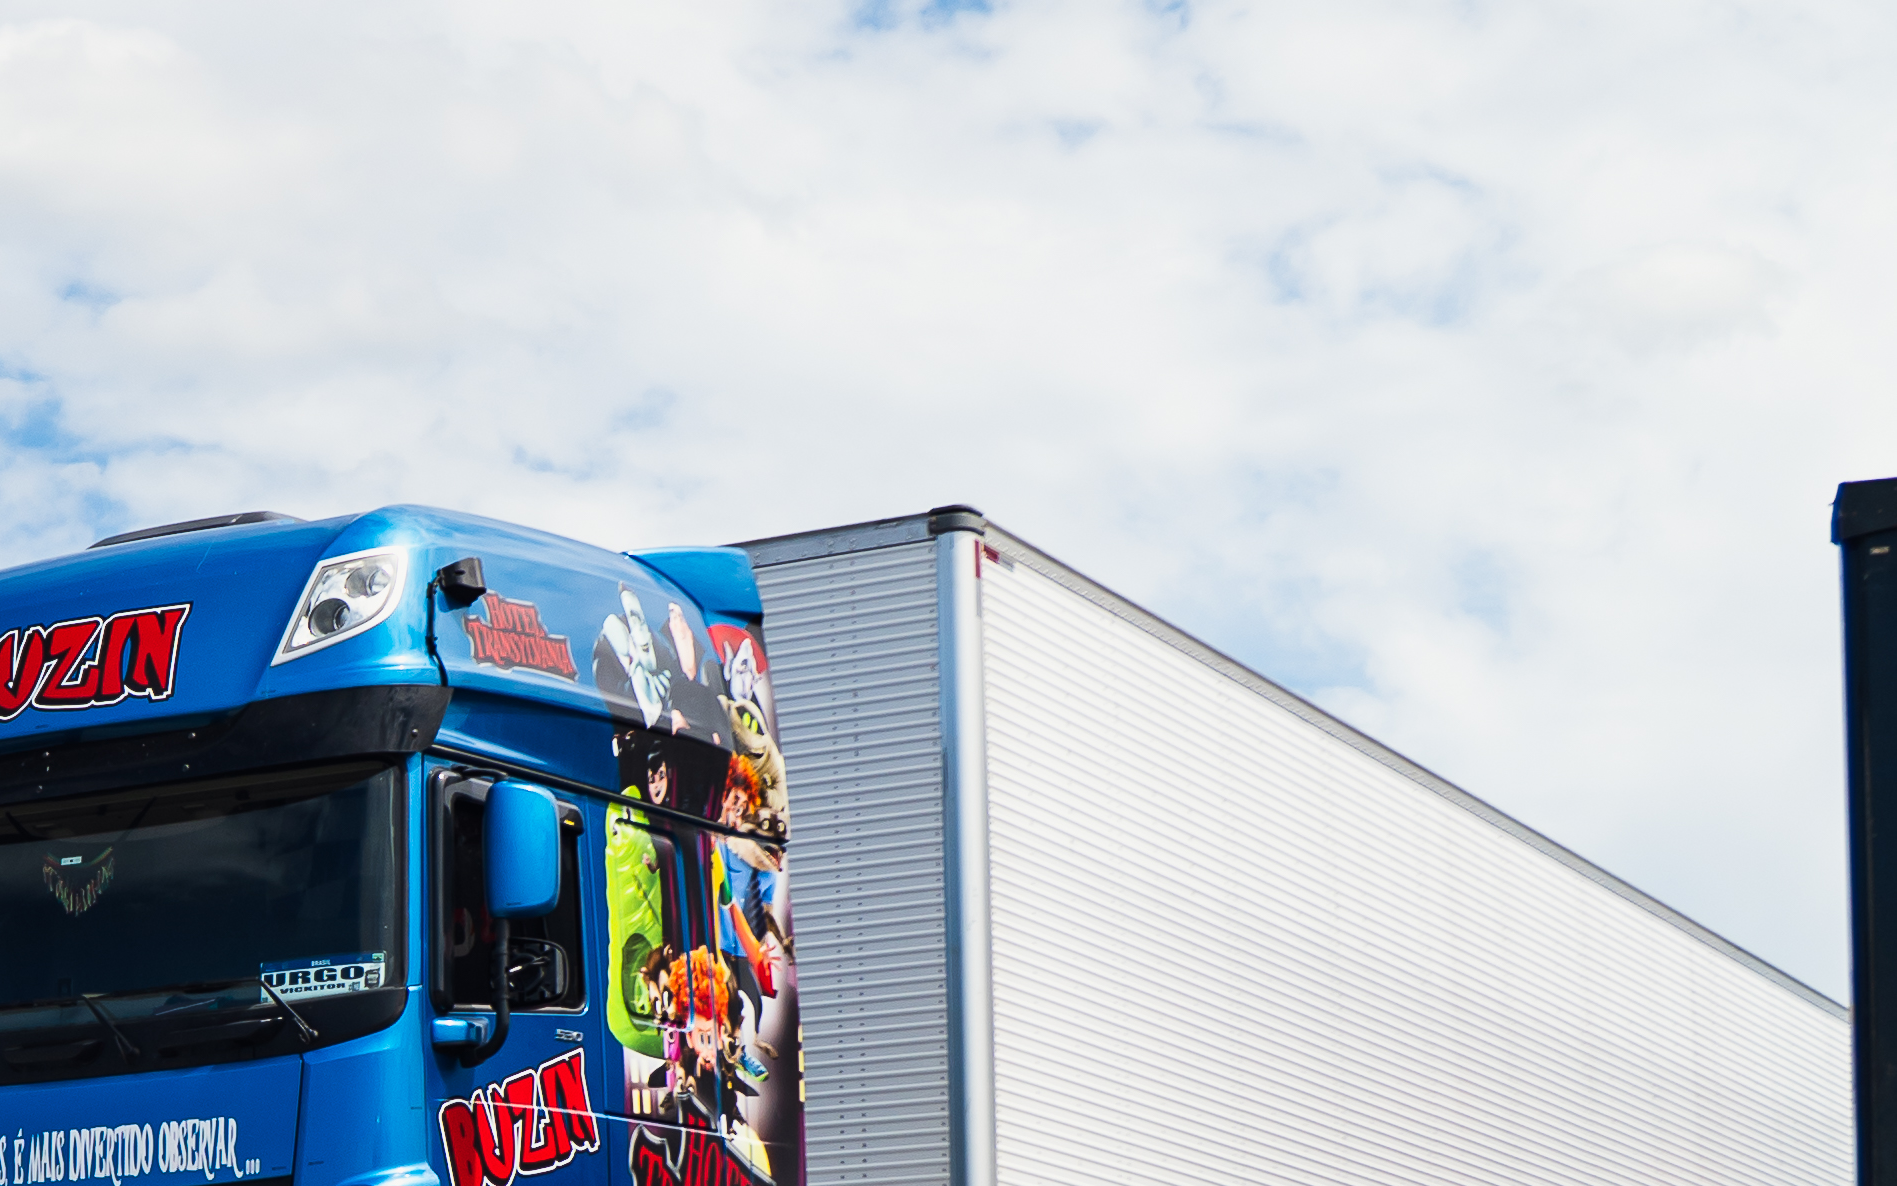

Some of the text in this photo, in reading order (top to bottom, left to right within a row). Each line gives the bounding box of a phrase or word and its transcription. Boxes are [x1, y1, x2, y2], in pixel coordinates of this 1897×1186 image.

[13, 1128, 24, 1185] É
[27, 1130, 65, 1185] MAIS
[68, 1123, 154, 1186] DIVERTIDO
